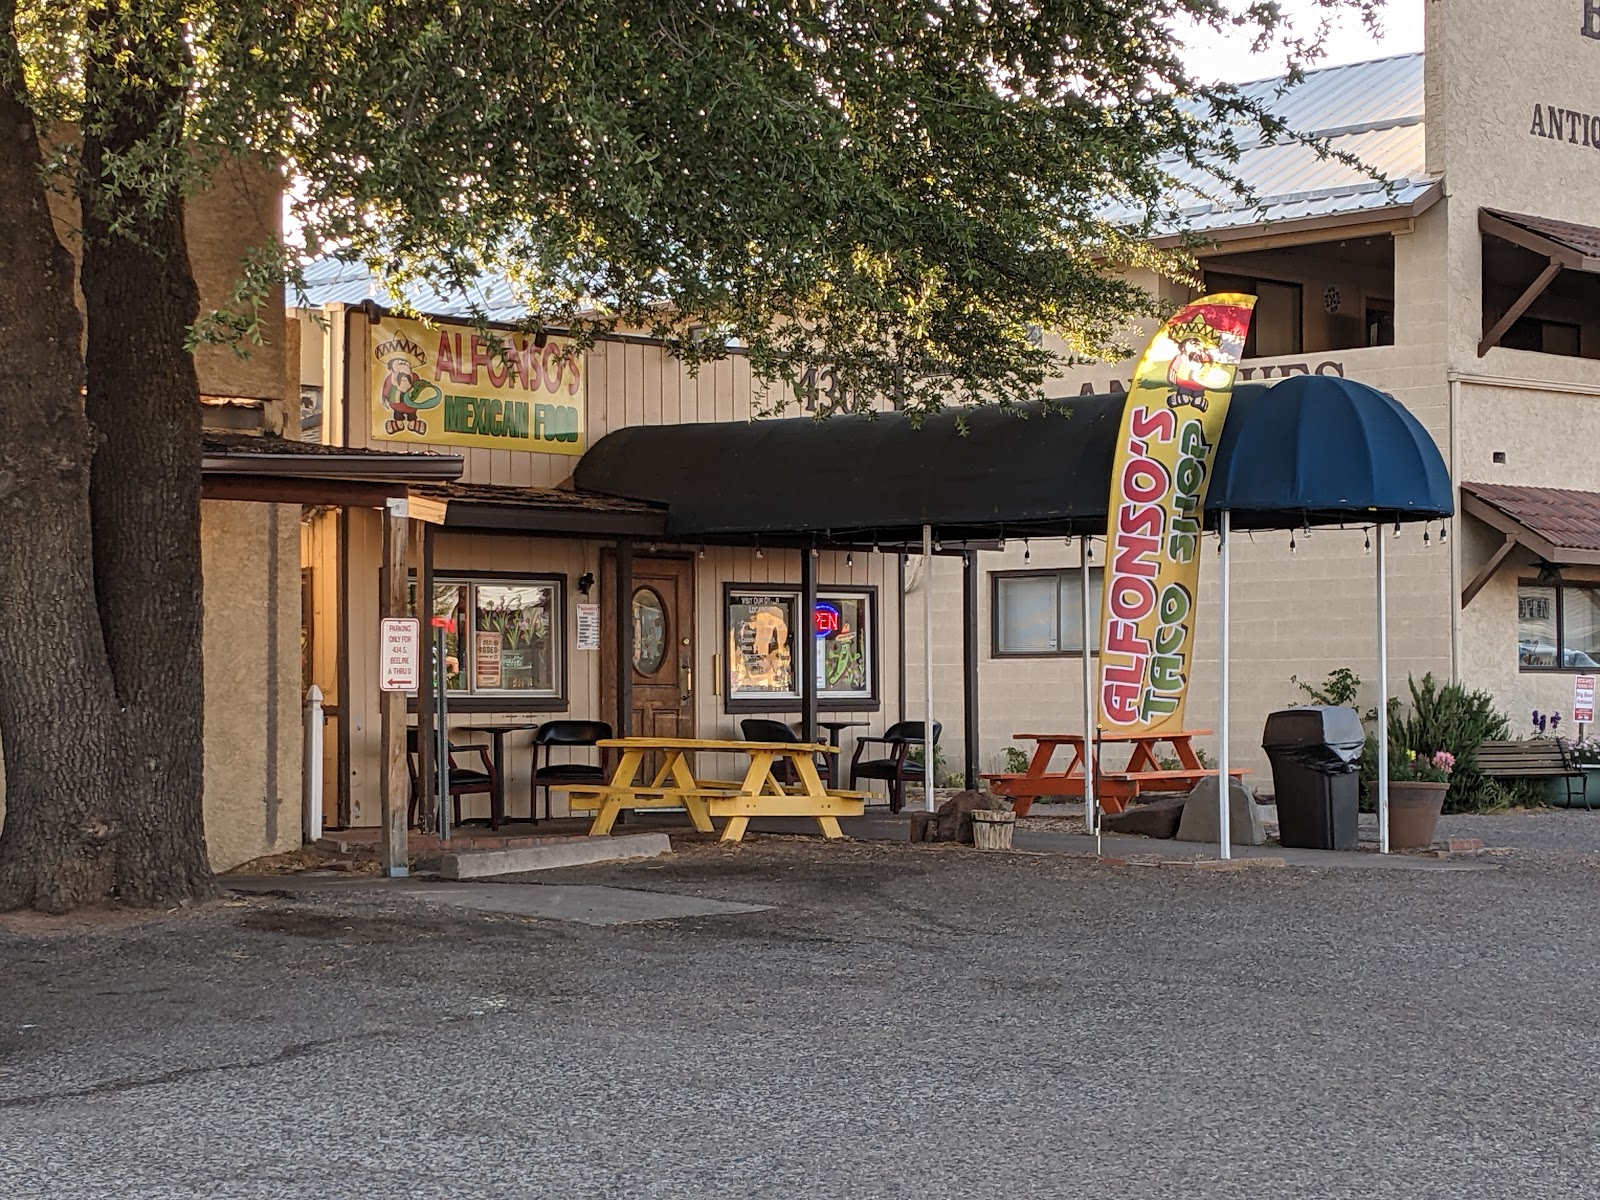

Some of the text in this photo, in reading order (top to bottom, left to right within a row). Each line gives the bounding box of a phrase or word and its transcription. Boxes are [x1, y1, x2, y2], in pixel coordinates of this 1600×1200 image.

[434, 330, 580, 396] ALFONSO'S
[444, 395, 578, 442] MEXICAN FOOD
[1102, 406, 1176, 725] ALFONSO'S
[1140, 419, 1210, 724] TACO SHOP
[388, 635, 412, 643] ONLY FOR
